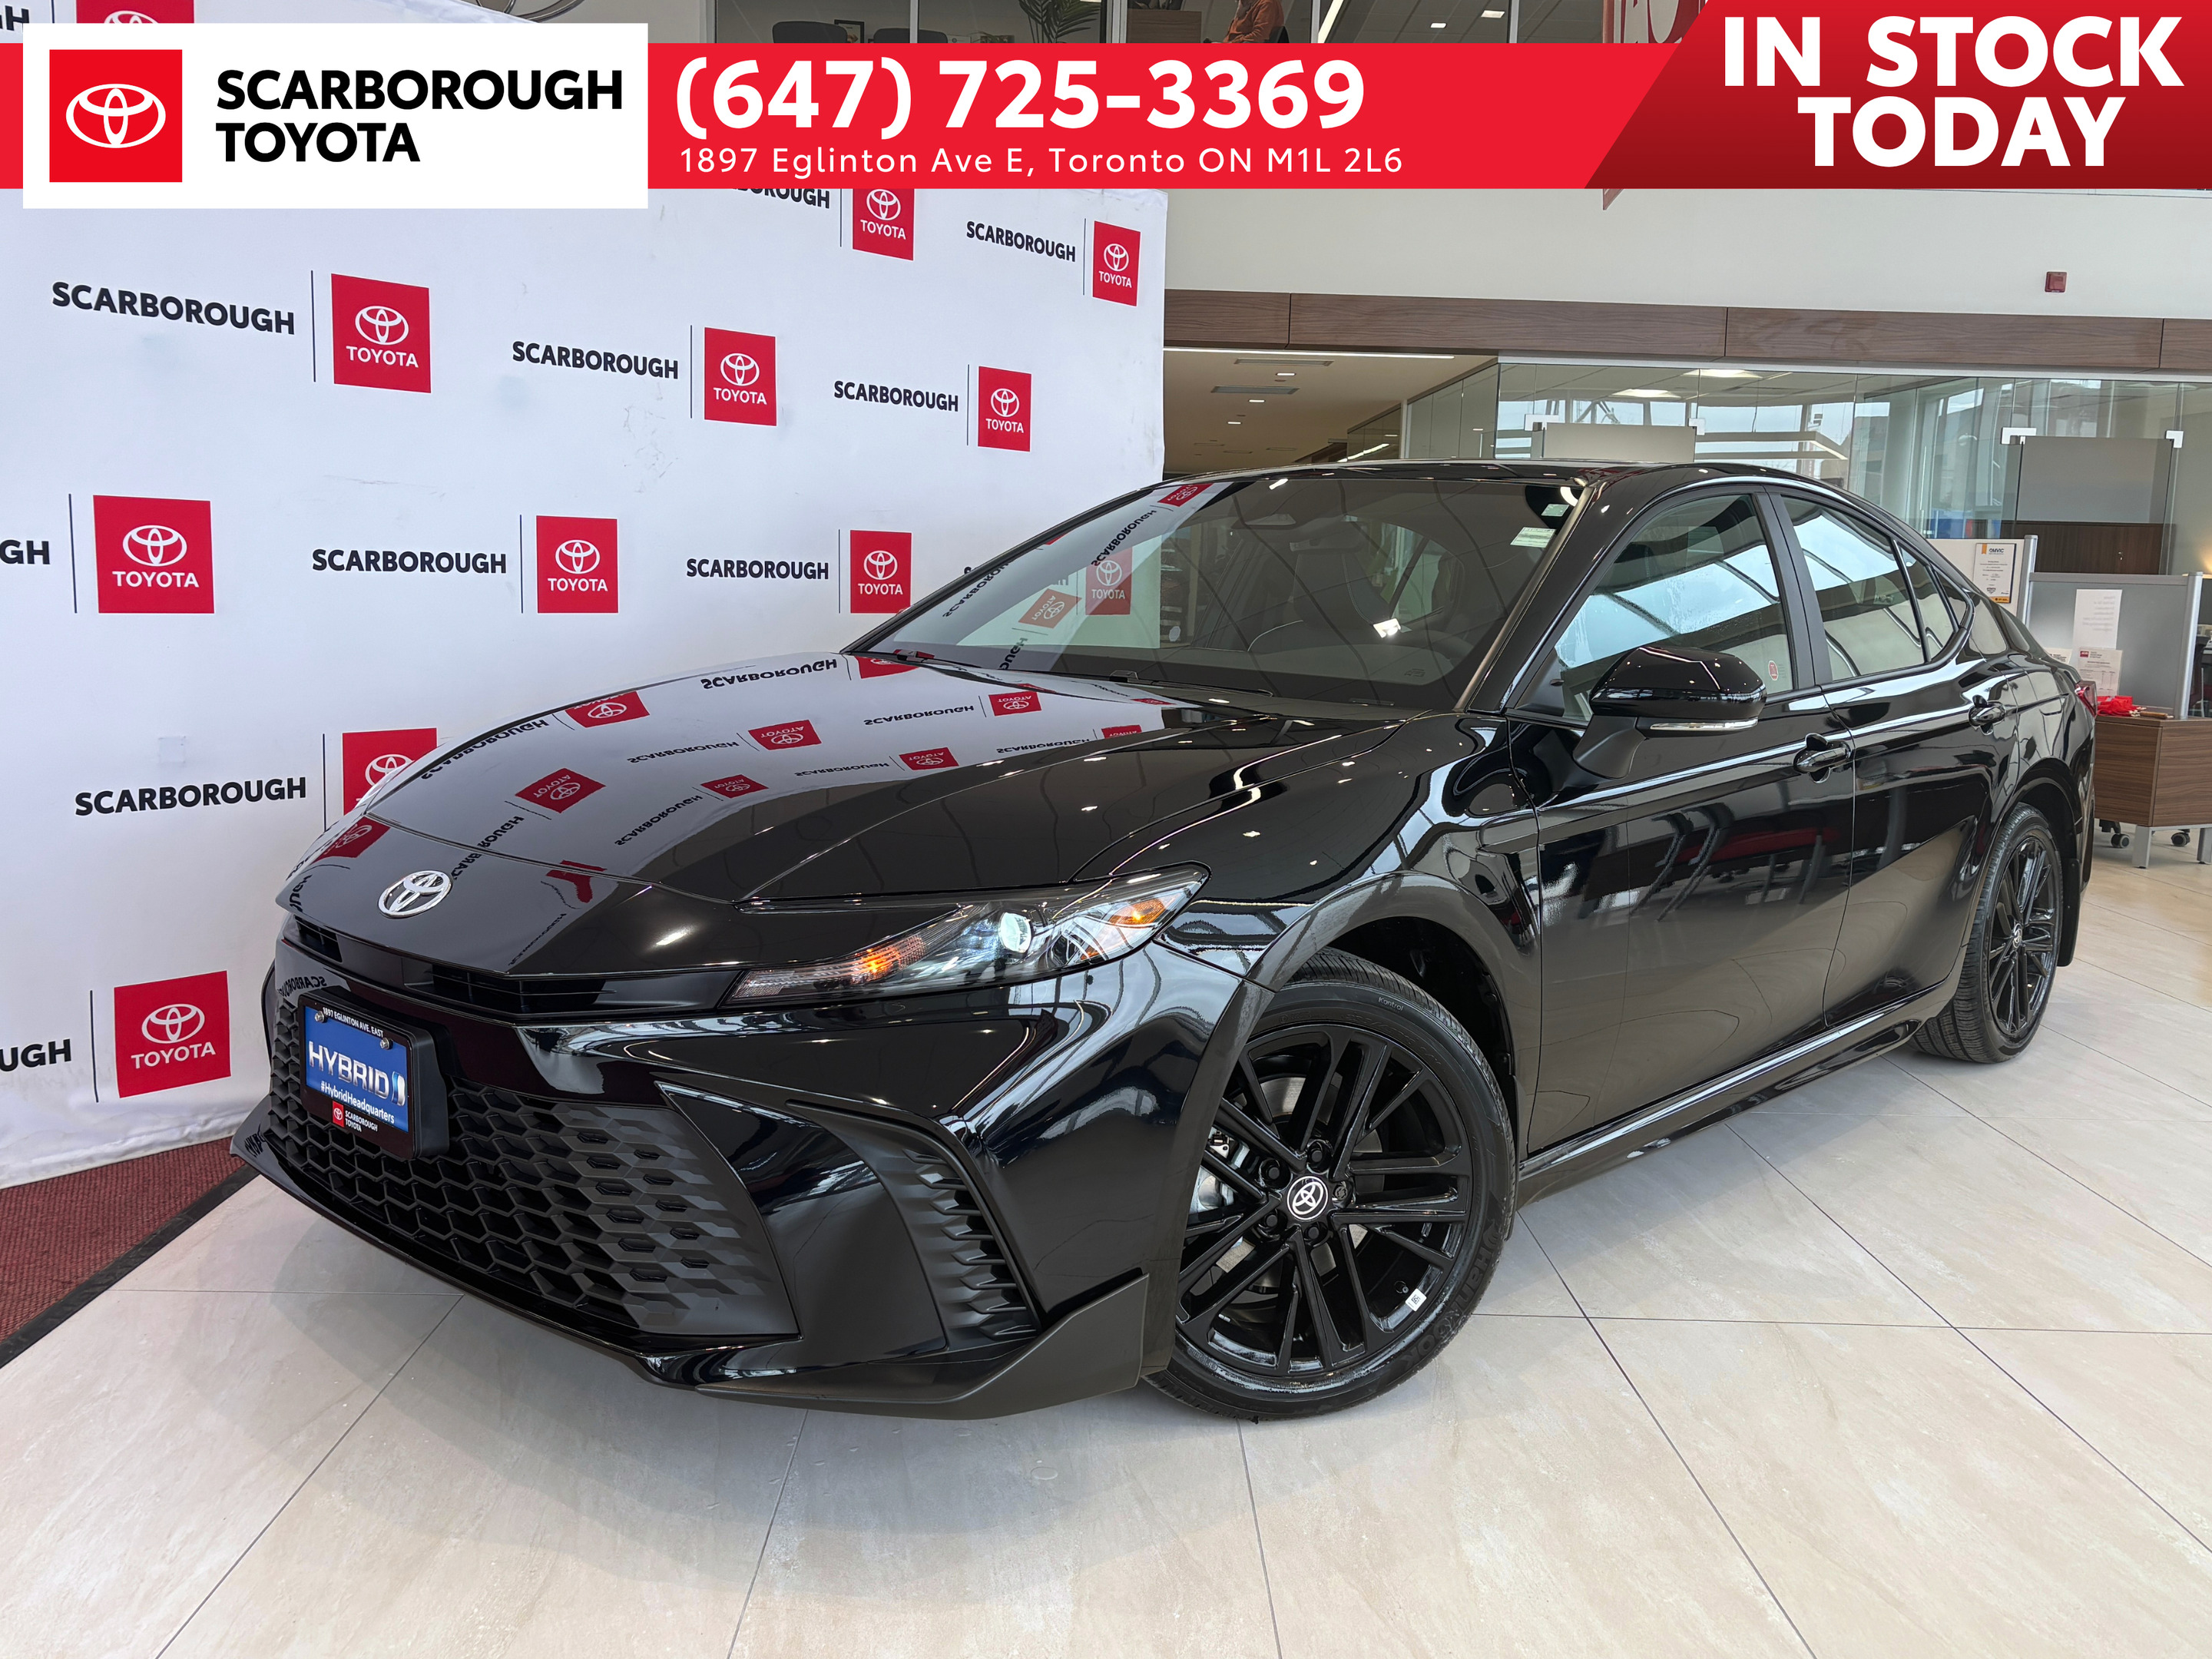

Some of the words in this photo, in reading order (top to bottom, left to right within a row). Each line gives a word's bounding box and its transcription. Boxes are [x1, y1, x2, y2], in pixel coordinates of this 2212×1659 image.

[860, 220, 906, 240] TOYOTA
[966, 221, 1076, 263] SCARBOROUGH
[1098, 270, 1132, 290] TOYOTA
[52, 282, 295, 335] SCARBOROUGH
[346, 346, 419, 369] TOYOTA
[512, 341, 678, 379] SCARBOROUGH
[713, 388, 767, 406] TOYOTA
[834, 381, 959, 412] SCARBOROUGH
[986, 419, 1024, 434] TOYOTA
[312, 548, 506, 574] SCARBOROUGH
[687, 558, 829, 580] SCARBOROUGH
[113, 571, 200, 588] TOYOTA
[548, 578, 608, 591] TOYOTA
[858, 582, 903, 595] TOYOTA
[1091, 588, 1125, 601] TOYOTA
[75, 777, 306, 816] SCARBOROUGH
[1379, 997, 1404, 1012] Kontrol
[323, 1007, 334, 1018] 1897
[334, 1012, 359, 1028] EGLINTON
[359, 1022, 370, 1033] AVE.
[372, 1026, 383, 1038] EAST
[131, 1041, 216, 1069] TOYOTA
[309, 1041, 389, 1099] HYBRID
[320, 1080, 394, 1124] #HybridHeadquarters
[345, 1111, 378, 1131] SCARBOROUGH
[345, 1118, 362, 1131] TOYOTA
